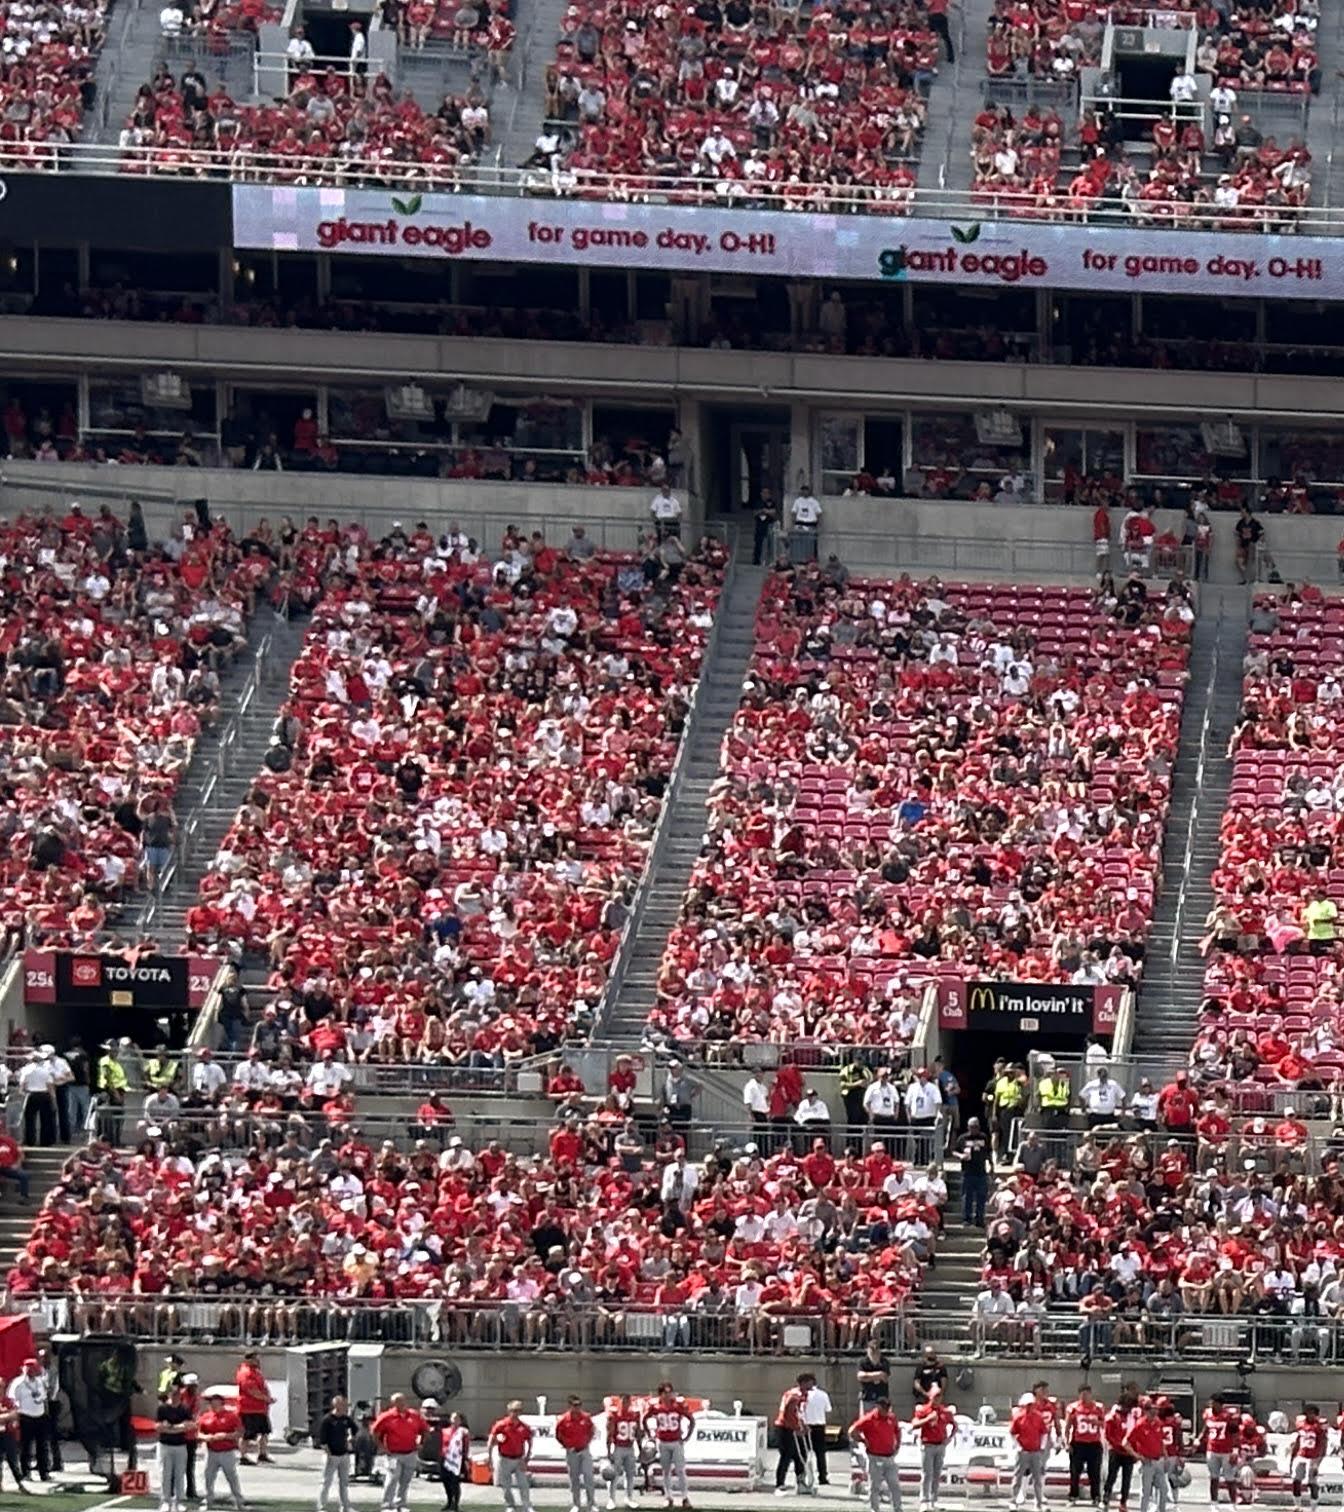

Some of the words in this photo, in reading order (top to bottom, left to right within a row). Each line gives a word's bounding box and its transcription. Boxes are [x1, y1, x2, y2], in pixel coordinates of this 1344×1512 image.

[317, 218, 396, 252] giant
[400, 222, 493, 254] eagle
[529, 221, 566, 244] for
[572, 227, 648, 252] game
[656, 228, 712, 257] day.
[720, 230, 775, 255] O-H!
[879, 245, 957, 277] giant
[961, 246, 1048, 277] eagle
[1082, 248, 1118, 272] for
[1125, 253, 1198, 277] game
[1208, 255, 1261, 280] day.
[1268, 257, 1323, 280] O-H!
[106, 966, 171, 983] TOYOTA
[1000, 996, 1024, 1012] i'm
[1025, 995, 1070, 1013] lovin'
[1072, 997, 1084, 1013] it
